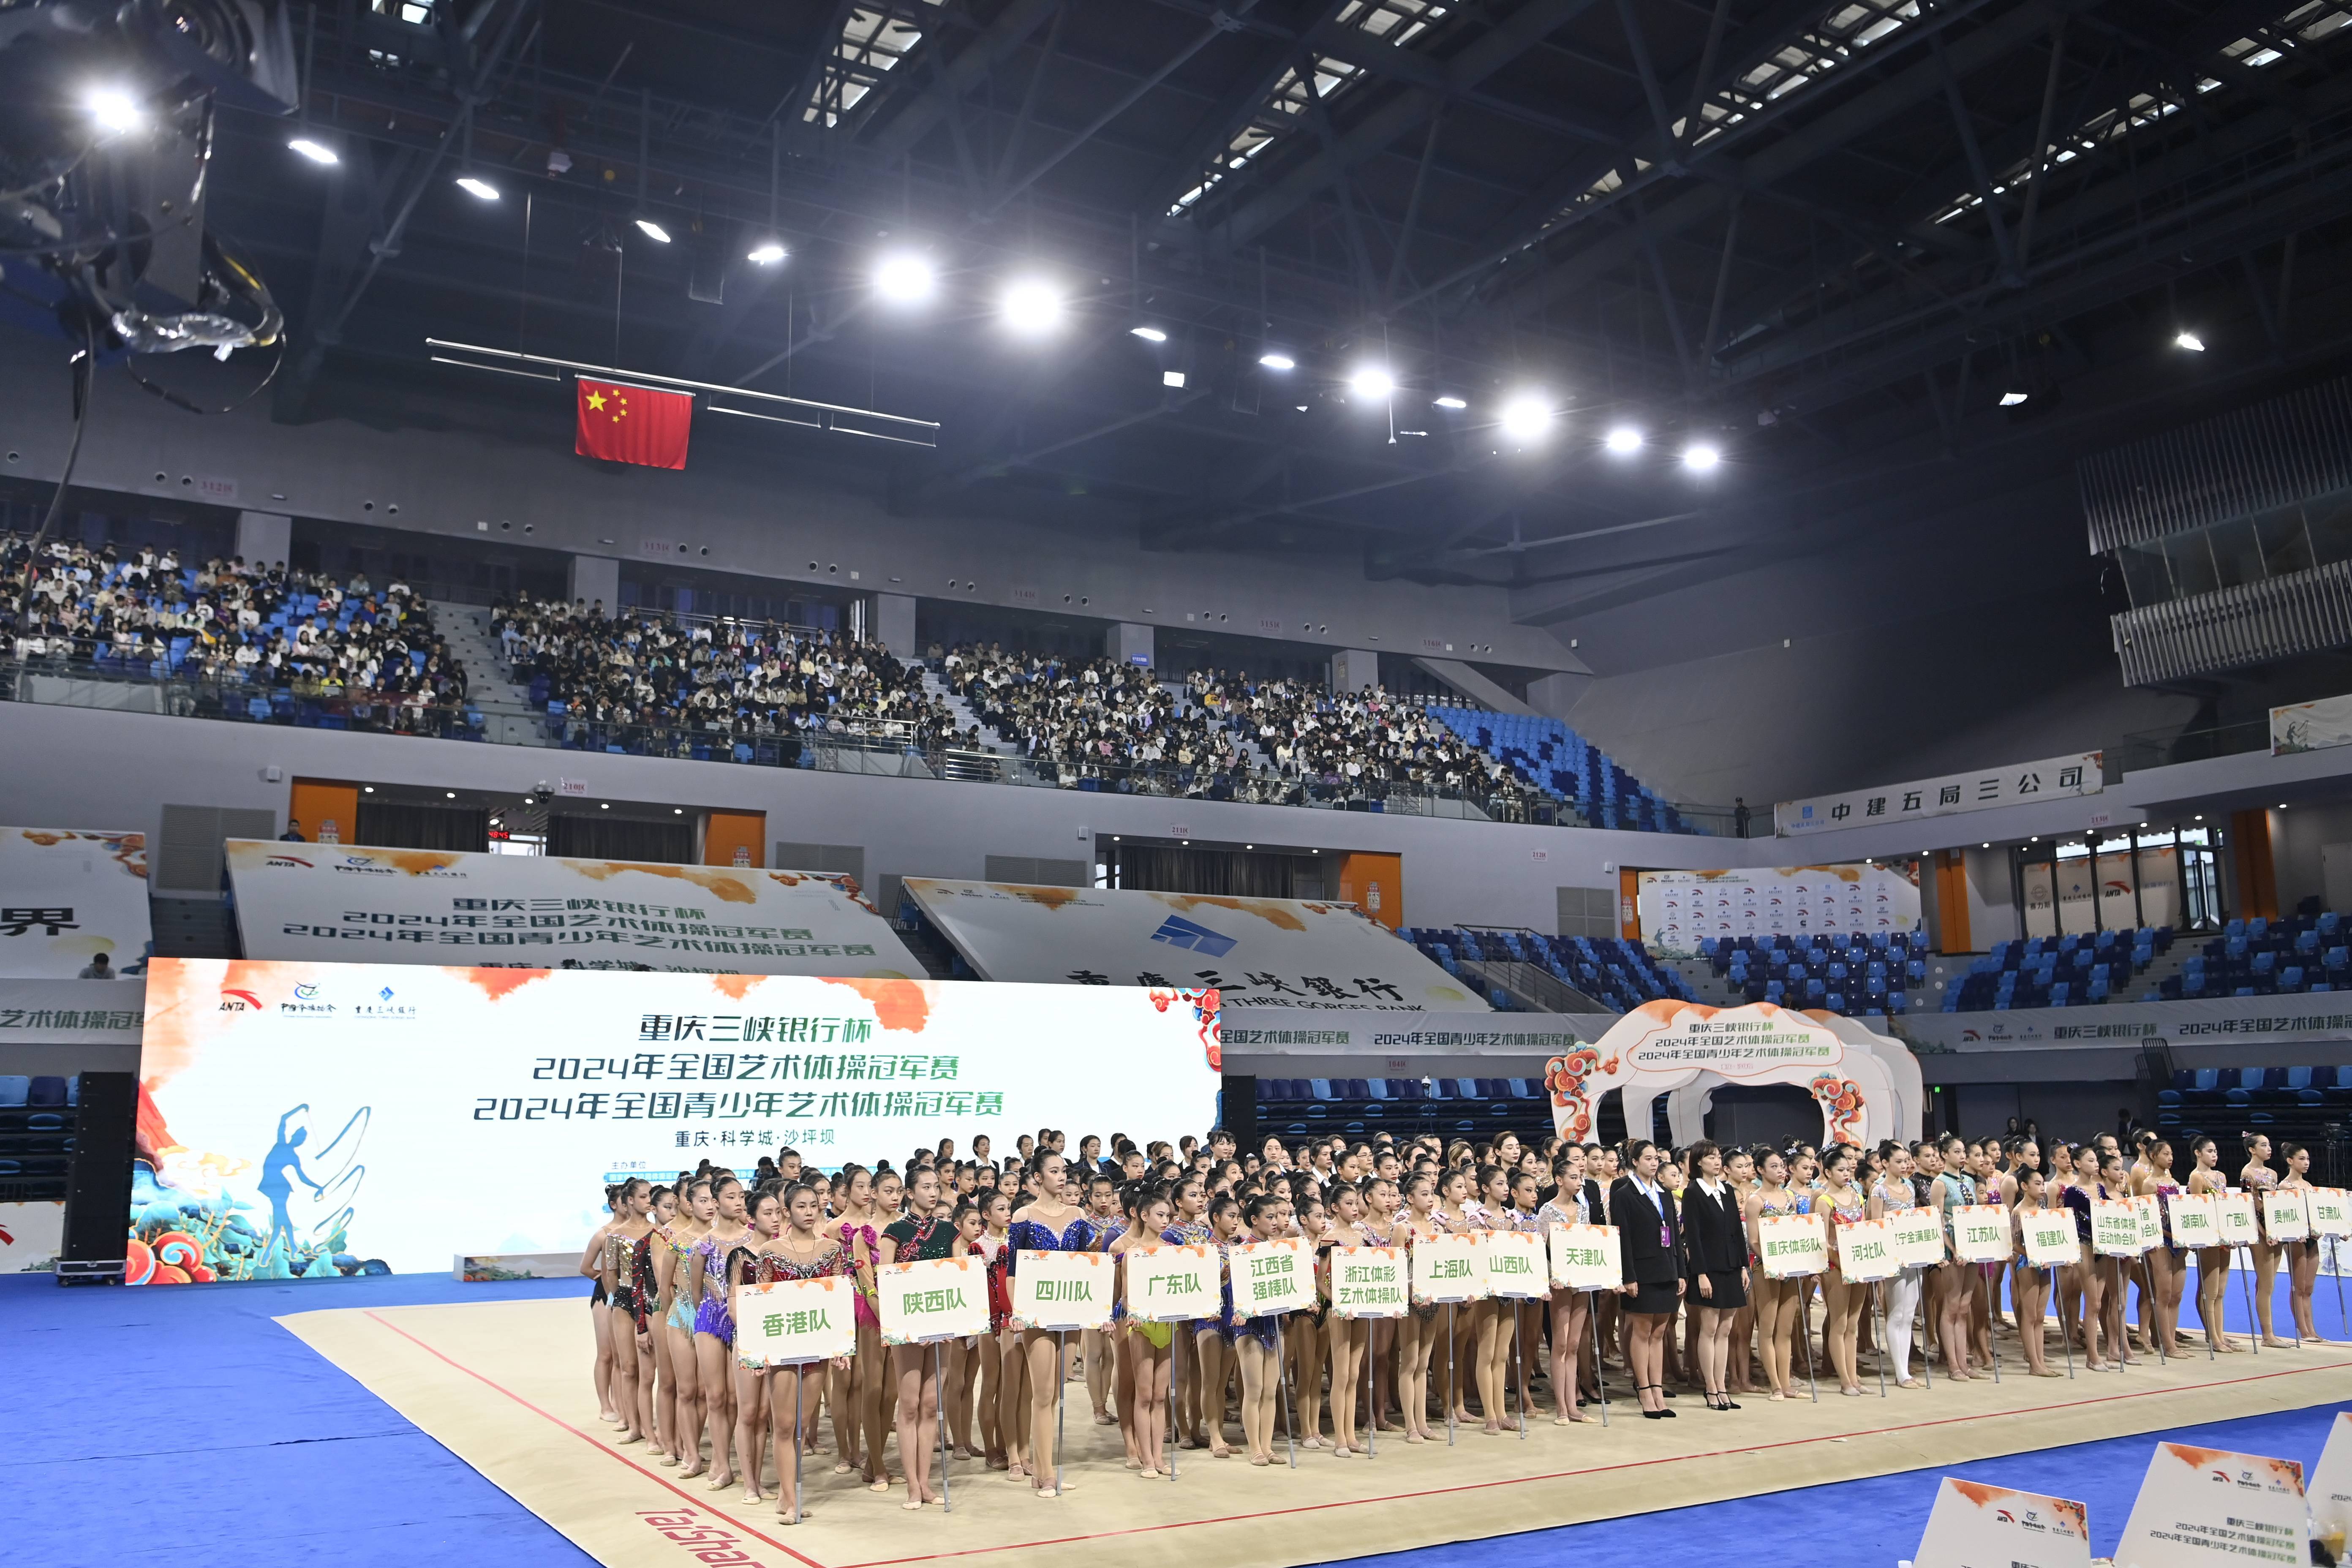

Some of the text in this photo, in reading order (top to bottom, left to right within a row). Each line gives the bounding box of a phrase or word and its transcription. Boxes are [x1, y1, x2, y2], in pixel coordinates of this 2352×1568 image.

[1832, 766, 2083, 822] 中建五局三公司
[2105, 889, 2121, 898] ANTA
[452, 897, 707, 920] 重庆三峡银行杯
[1, 907, 80, 936] 界
[343, 911, 814, 941] 2024年全国艺术体操冠军赛
[283, 923, 877, 956] 2024年全国青少年艺术体操冠军赛
[219, 1002, 245, 1011] ANTA
[1227, 996, 1291, 1008] THREE
[638, 1014, 873, 1043] 重庆三峡银行杯
[1689, 1021, 1774, 1034] 重庆三峡银行杯
[2054, 1022, 2157, 1040] 重庆三峡银行杯
[1374, 1031, 1576, 1047] 2024年全国青少年艺术体操冠军赛
[1655, 1033, 1810, 1048] 2024年全国艺术体操冠军赛
[1638, 1046, 1830, 1061] 2024年全国青少年艺术体操冠军赛
[532, 1054, 960, 1081] 2024年全国艺术体操冠军赛
[473, 1091, 1004, 1121] 2024年全国青少年艺术体操冠军赛
[675, 1128, 835, 1149] 重庆·科学城·沙坪坝
[2097, 1215, 2137, 1229] 山东省体操
[2180, 1214, 2209, 1229] 湖南队
[2226, 1212, 2250, 1228] 广西队
[2274, 1209, 2300, 1223] 贵州队
[2317, 1205, 2343, 1221] 甘肃队
[1966, 1225, 2001, 1243] 江苏队
[2036, 1229, 2069, 1247] 福建队
[2098, 1231, 2138, 1246] 运动协会队
[1566, 1247, 1607, 1267] 天津队
[1767, 1237, 1823, 1257] 重庆体彩队
[1851, 1241, 1886, 1263] 河北队
[1250, 1254, 1294, 1278] 江西省
[1344, 1265, 1396, 1284] 浙江体彩
[1429, 1258, 1473, 1279] 上海队
[1489, 1255, 1533, 1275] 山西队
[1035, 1280, 1093, 1302] 四川队
[1148, 1272, 1202, 1296] 广东队
[1252, 1276, 1298, 1301] 强棒队
[903, 1287, 967, 1315] 陕西队
[1339, 1287, 1403, 1304] 艺术体操队
[762, 1308, 831, 1338] 香港队
[2227, 1516, 2295, 1536] 重庆三峡银行杯
[2175, 1522, 2296, 1551] 2024年全国艺术体操冠军赛
[2150, 1530, 2297, 1564] 2024年全国青少年艺术体操冠军赛
